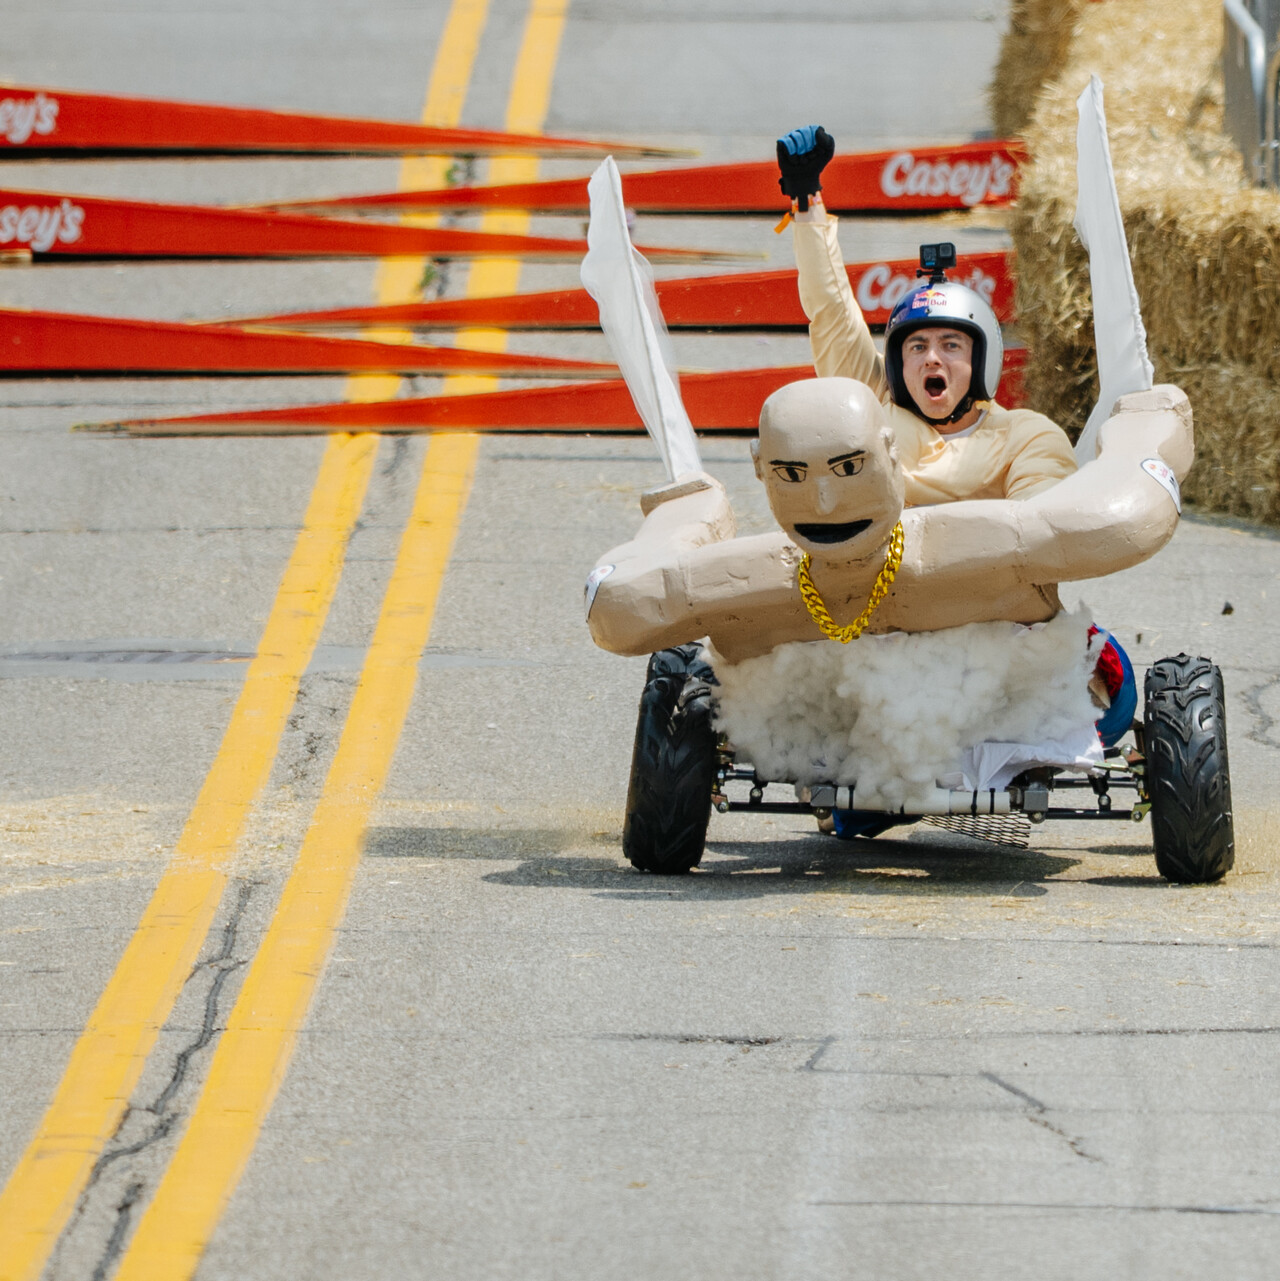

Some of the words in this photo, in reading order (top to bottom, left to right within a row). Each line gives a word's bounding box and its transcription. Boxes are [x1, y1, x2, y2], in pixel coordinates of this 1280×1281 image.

[880, 151, 1013, 206] Casey's
[857, 263, 996, 311] Ca's
[912, 298, 929, 309] Red
